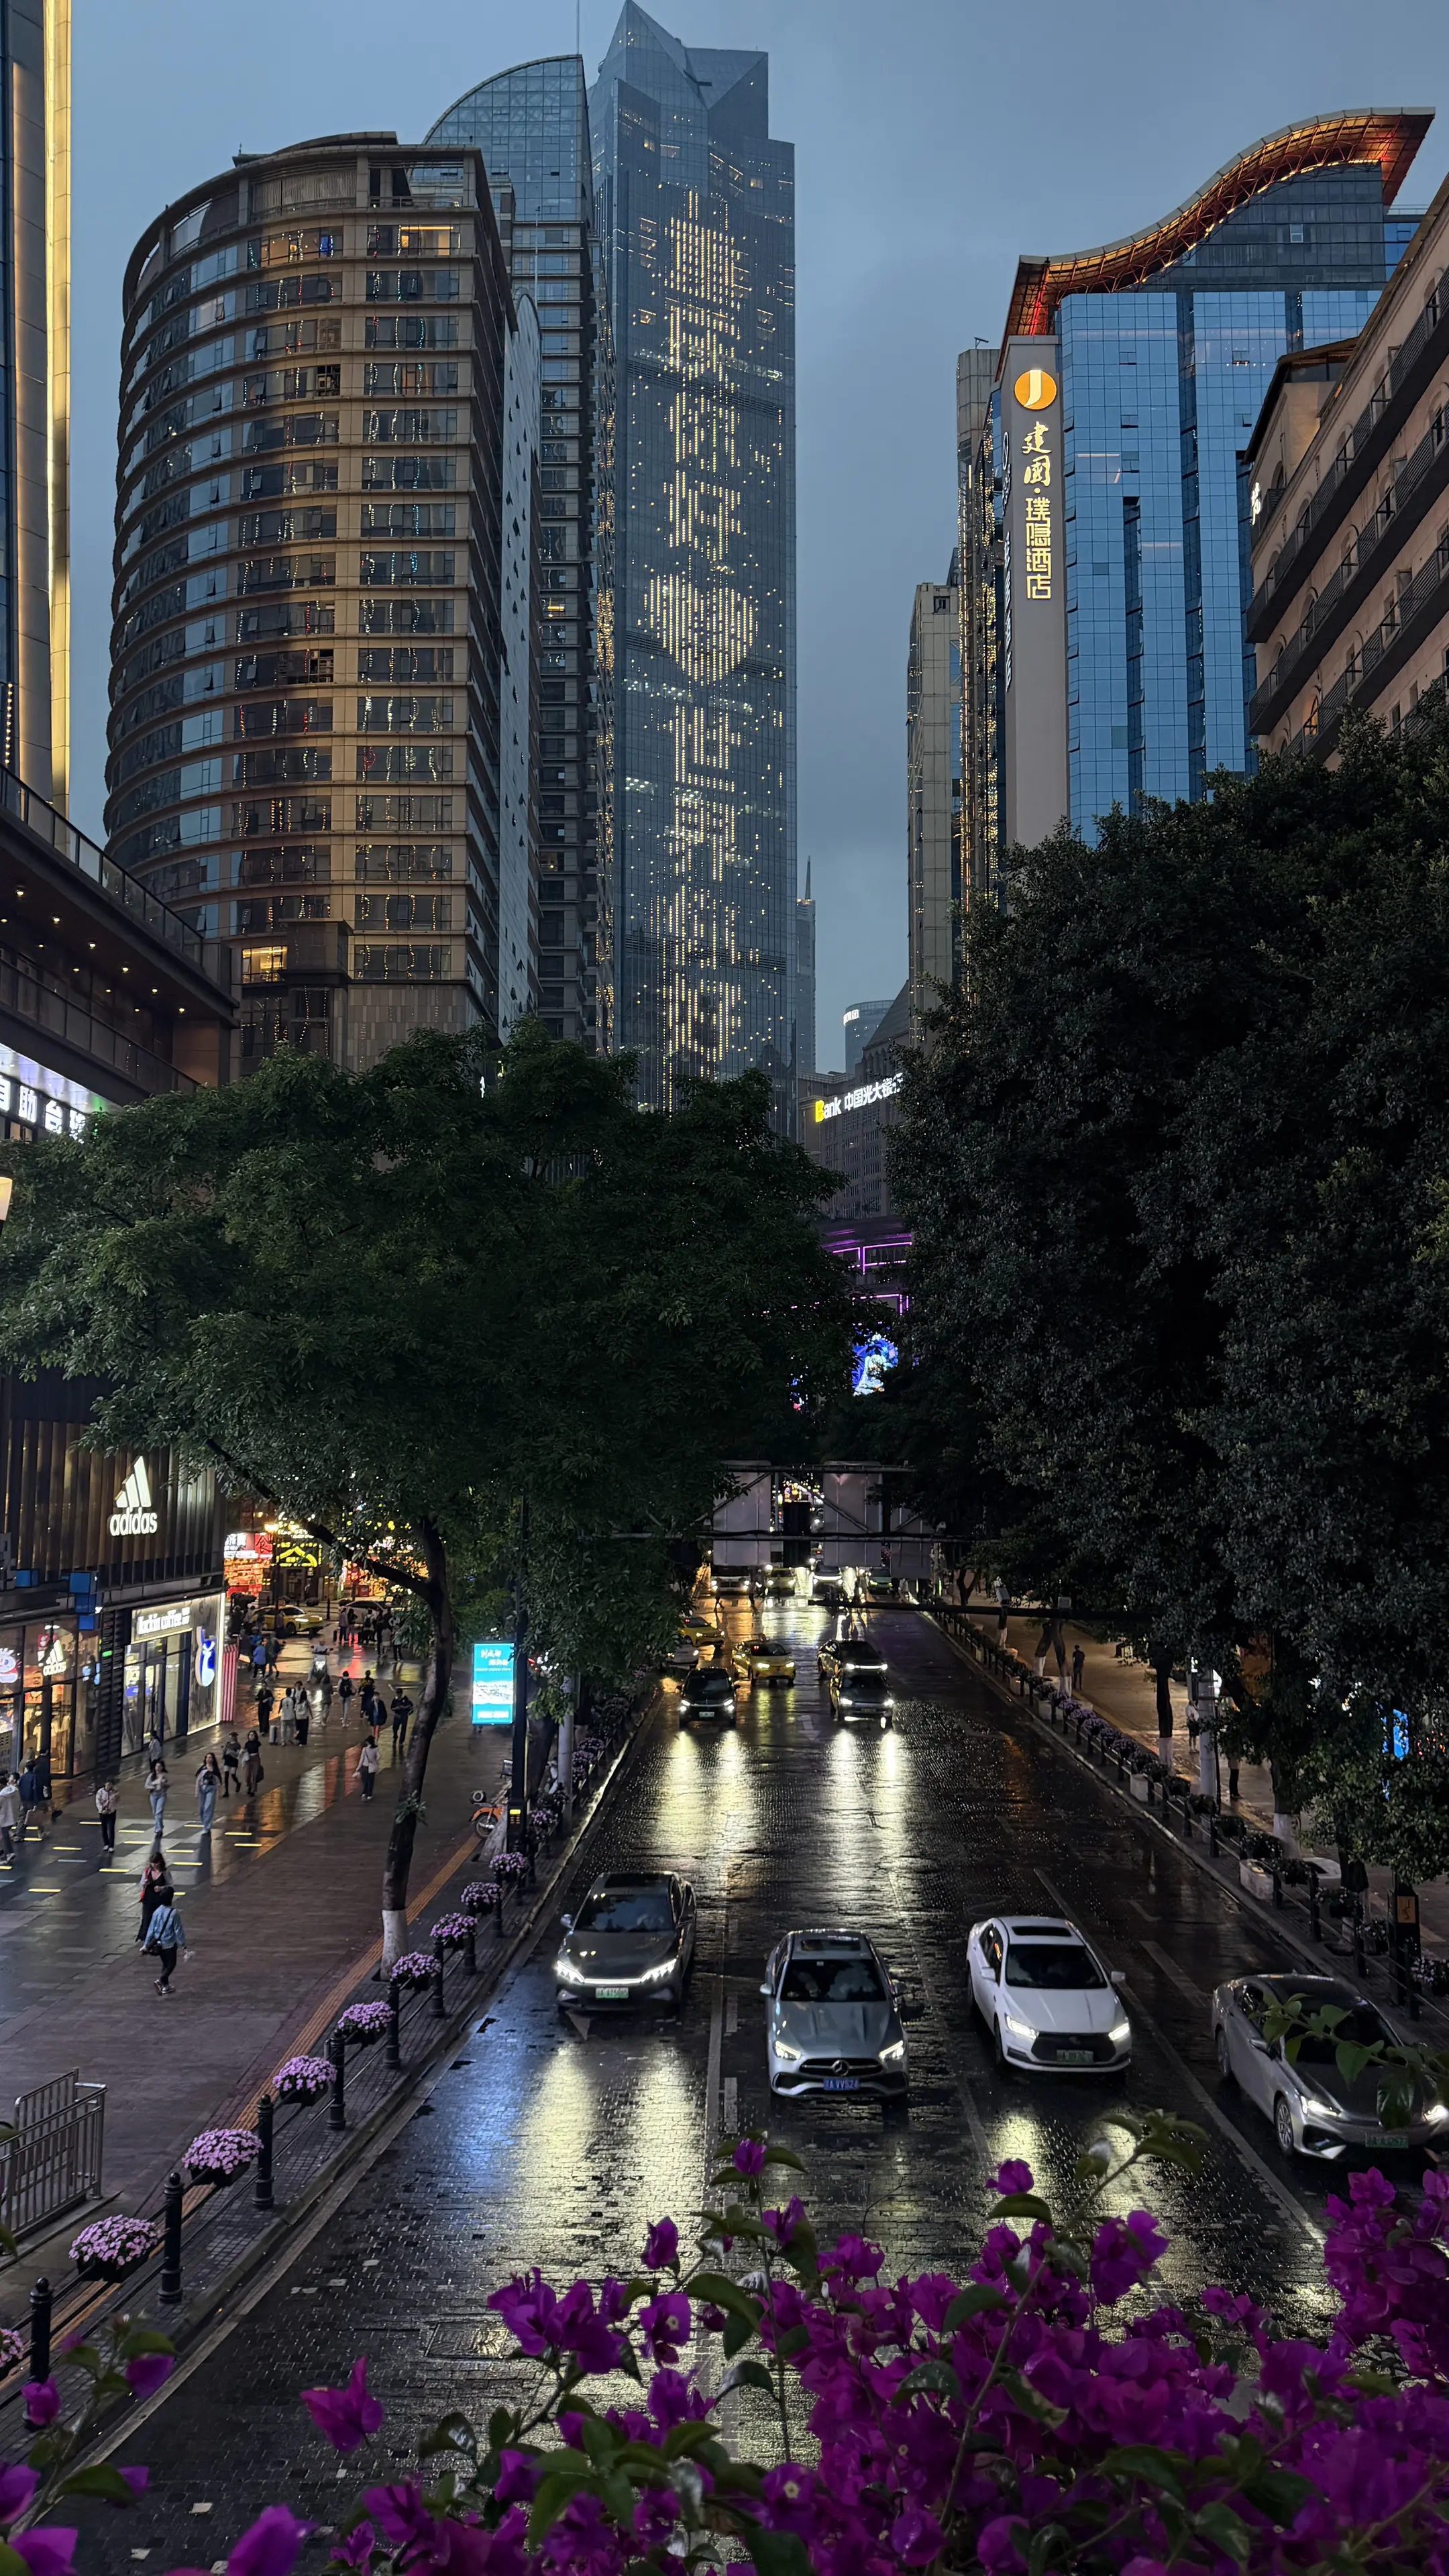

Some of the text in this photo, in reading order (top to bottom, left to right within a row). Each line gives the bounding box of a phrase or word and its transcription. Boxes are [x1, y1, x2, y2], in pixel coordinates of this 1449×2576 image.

[815, 1097, 842, 1123] Bank
[110, 1509, 158, 1536] adidas
[161, 1609, 182, 1630] coffee
